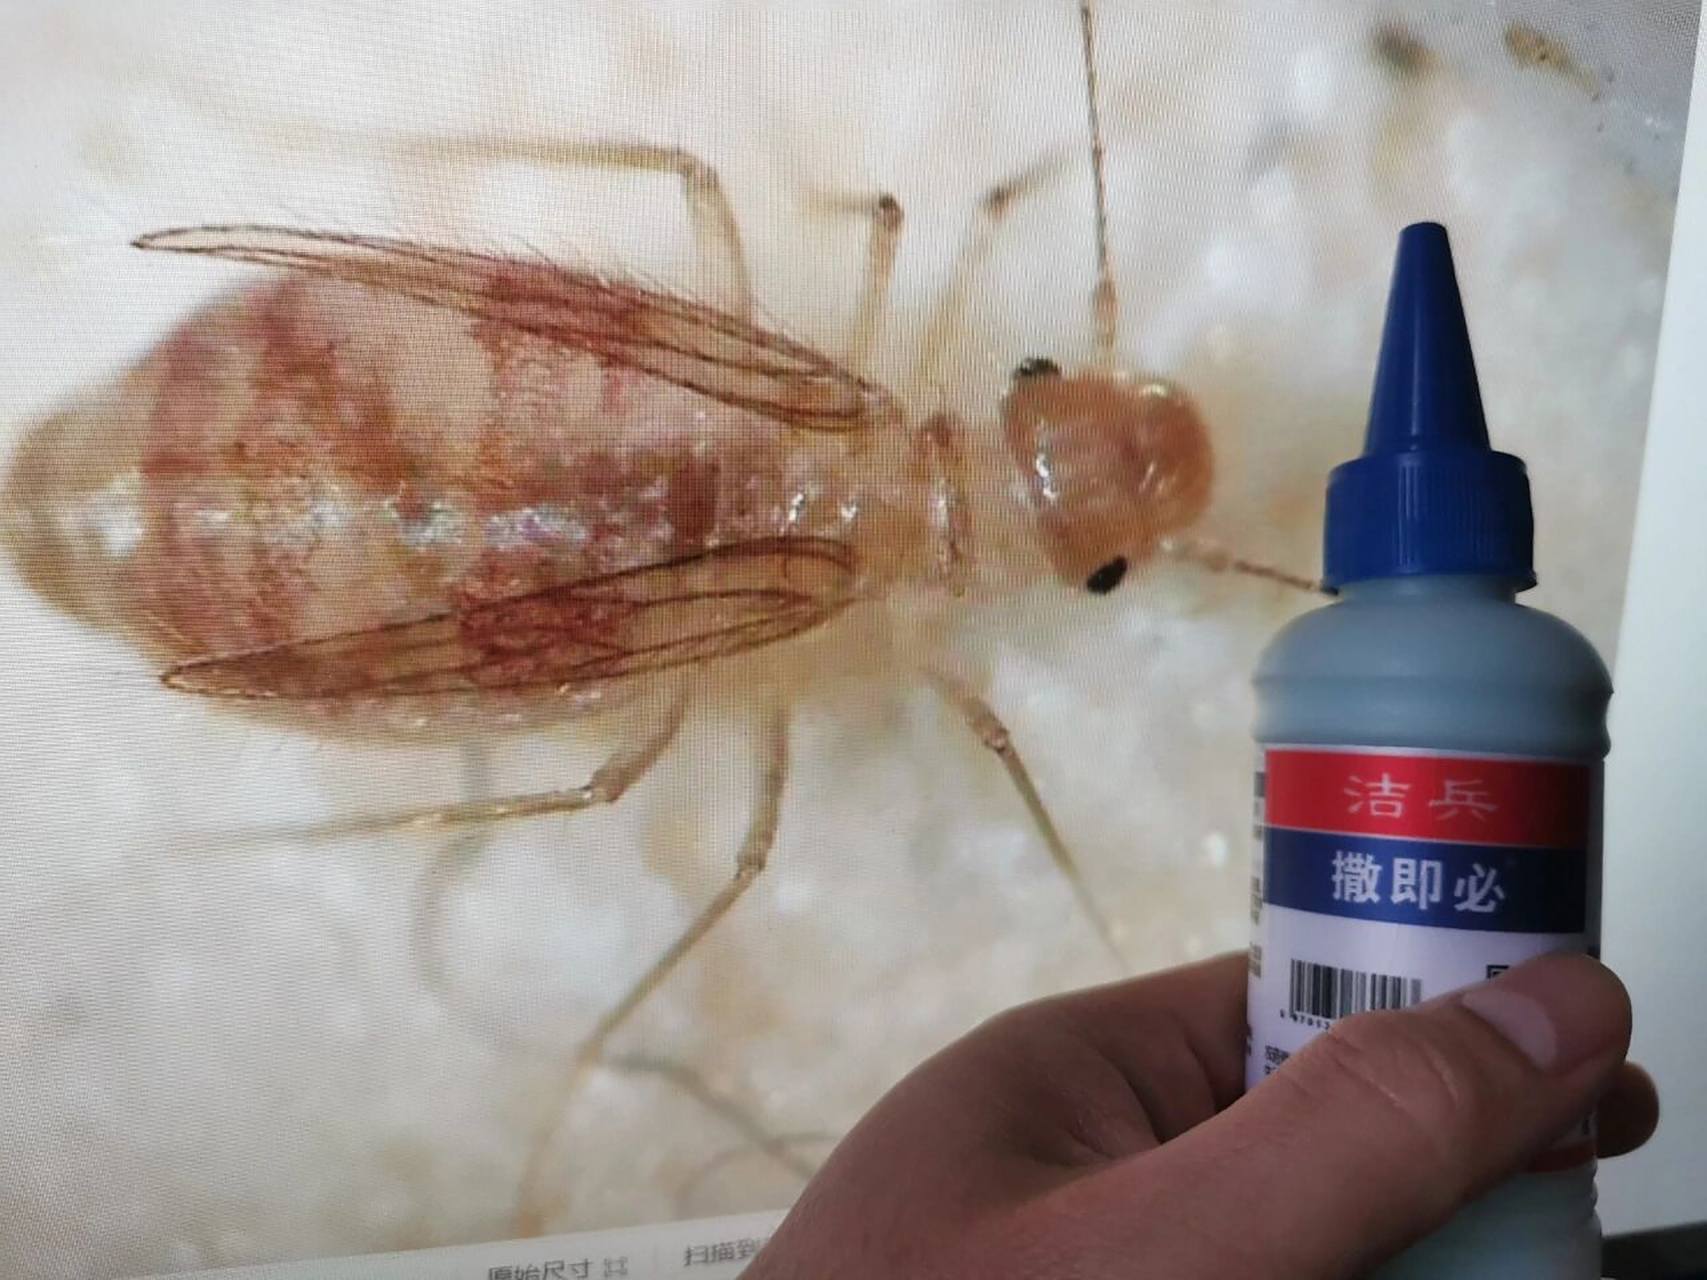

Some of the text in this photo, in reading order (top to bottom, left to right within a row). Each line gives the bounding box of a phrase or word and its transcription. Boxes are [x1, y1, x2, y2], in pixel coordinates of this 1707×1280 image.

[1345, 773, 1497, 819] 洁兵
[1332, 850, 1504, 913] 撒即必
[488, 1258, 594, 1280] 原始尺寸
[684, 1238, 766, 1266] 扫描到
